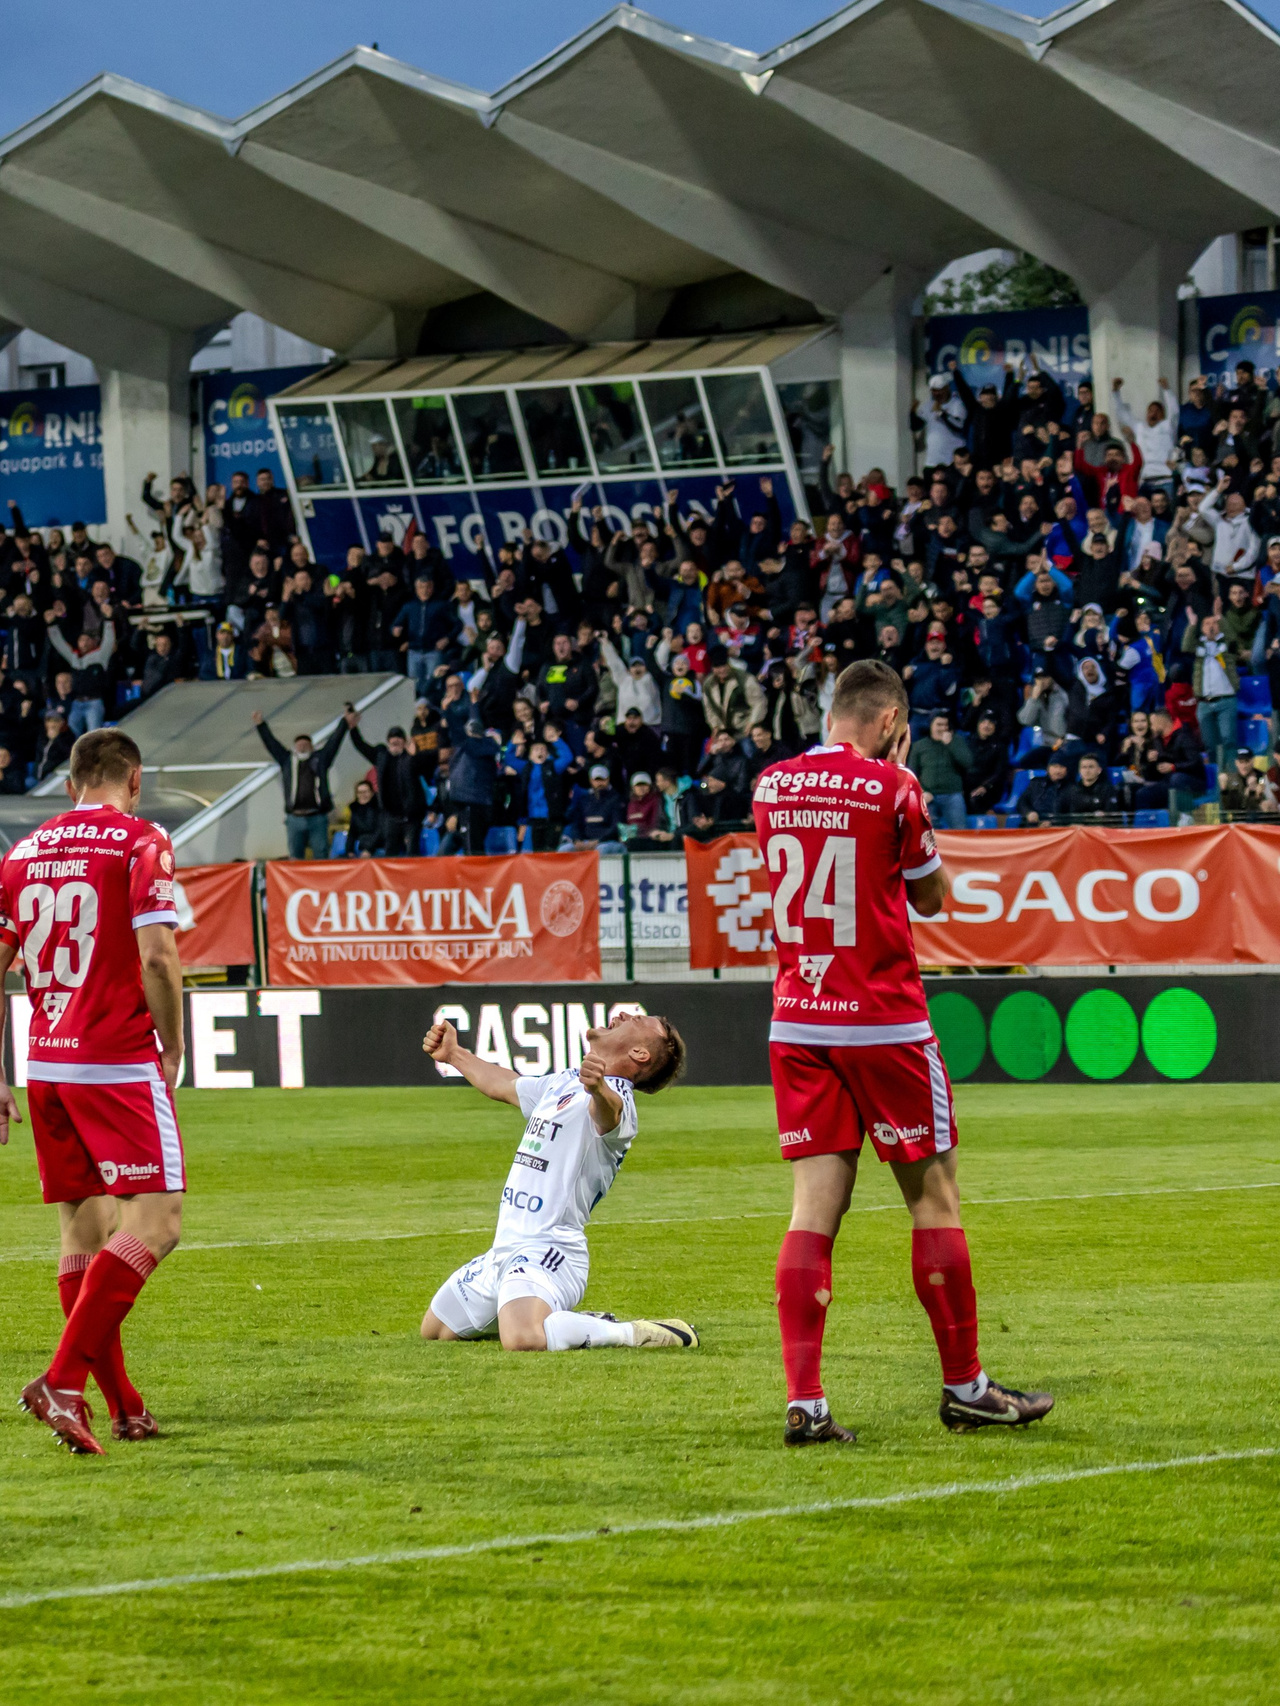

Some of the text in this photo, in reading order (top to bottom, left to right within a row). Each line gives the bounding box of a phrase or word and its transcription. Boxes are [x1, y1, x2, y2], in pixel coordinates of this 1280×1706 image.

[73, 451, 84, 468] &
[769, 770, 884, 795] Regata.ro
[844, 798, 881, 812] Parchet
[768, 809, 850, 830] VELKOVSKI
[32, 822, 128, 846] Regata.ro
[93, 847, 124, 858] Parchet
[26, 859, 89, 880] PATRICHE
[766, 833, 857, 947] 24
[285, 882, 534, 944] CARPATINA
[17, 881, 99, 989] 23
[286, 945, 318, 962] APA
[410, 944, 433, 960] CU
[434, 941, 495, 960] SUFLET
[497, 940, 534, 958] BUN
[800, 998, 859, 1012] GAMING
[38, 1036, 80, 1049] GAMING
[118, 1162, 160, 1176] Tehnic
[532, 1159, 544, 1170] 0%
